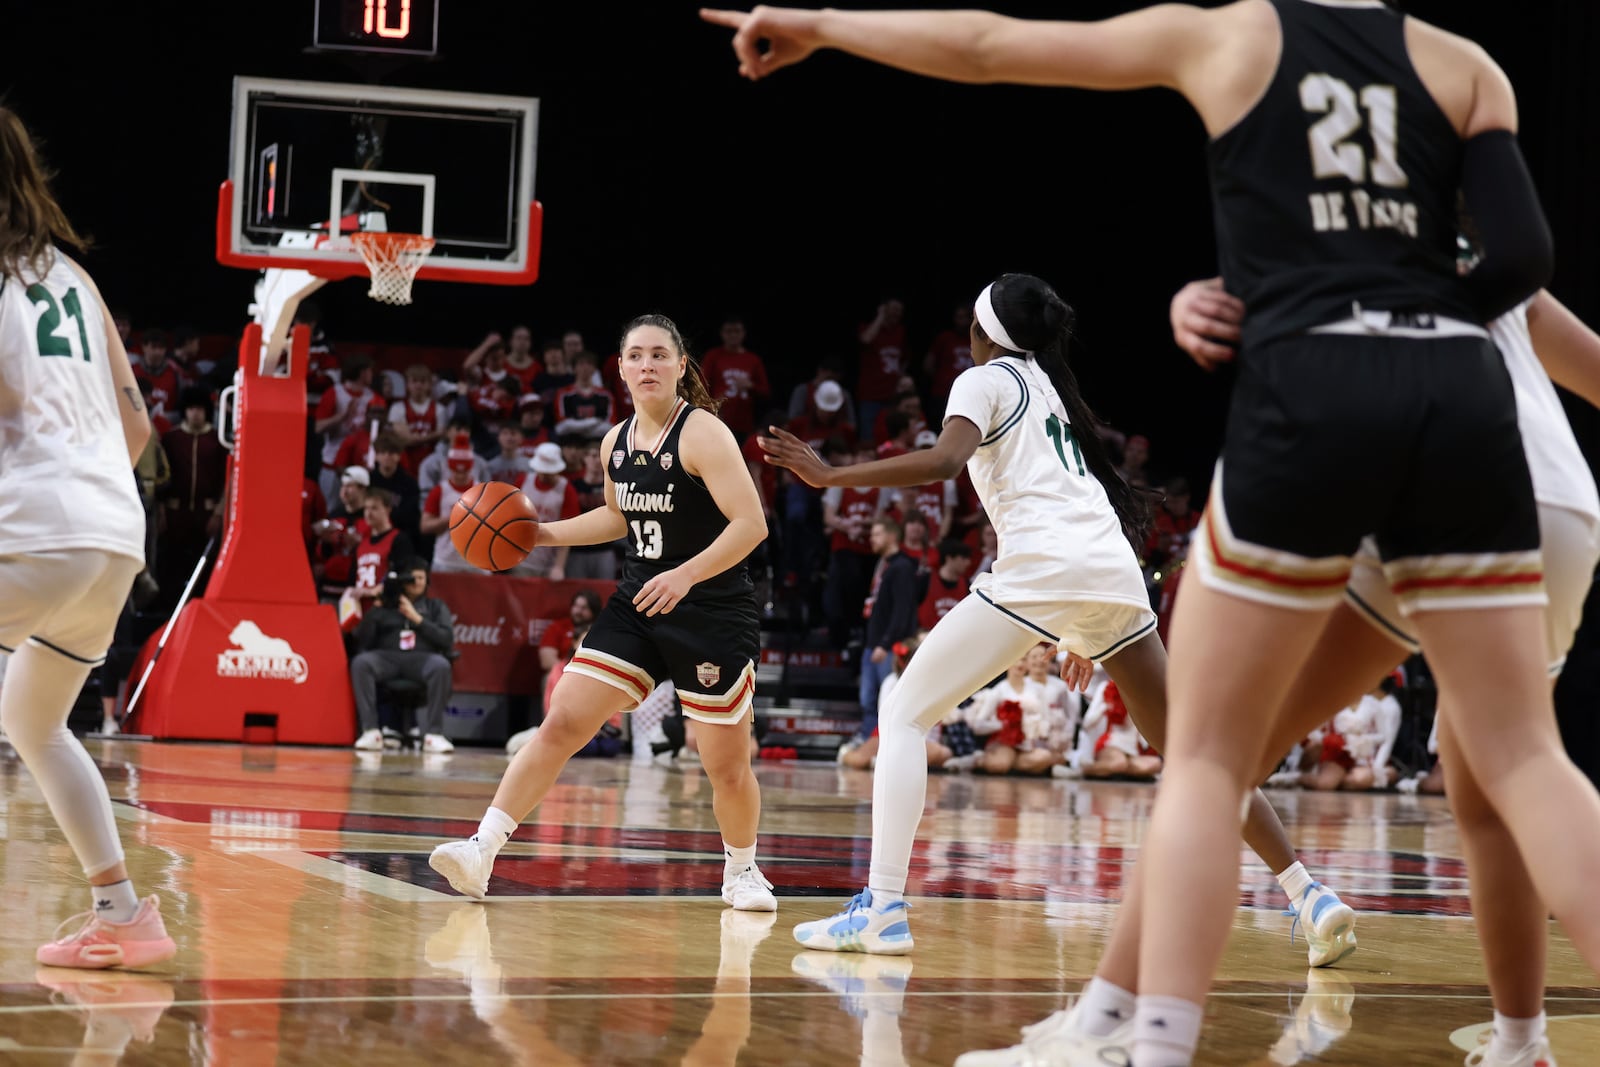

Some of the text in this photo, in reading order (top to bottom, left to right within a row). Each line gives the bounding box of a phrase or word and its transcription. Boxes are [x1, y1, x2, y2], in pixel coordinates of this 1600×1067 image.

[363, 0, 411, 39] 10
[1298, 72, 1409, 189] 21
[1308, 192, 1349, 232] DE
[25, 283, 92, 362] 21
[614, 481, 675, 513] Miami
[630, 520, 664, 560] 13
[217, 653, 303, 672] KEMBA
